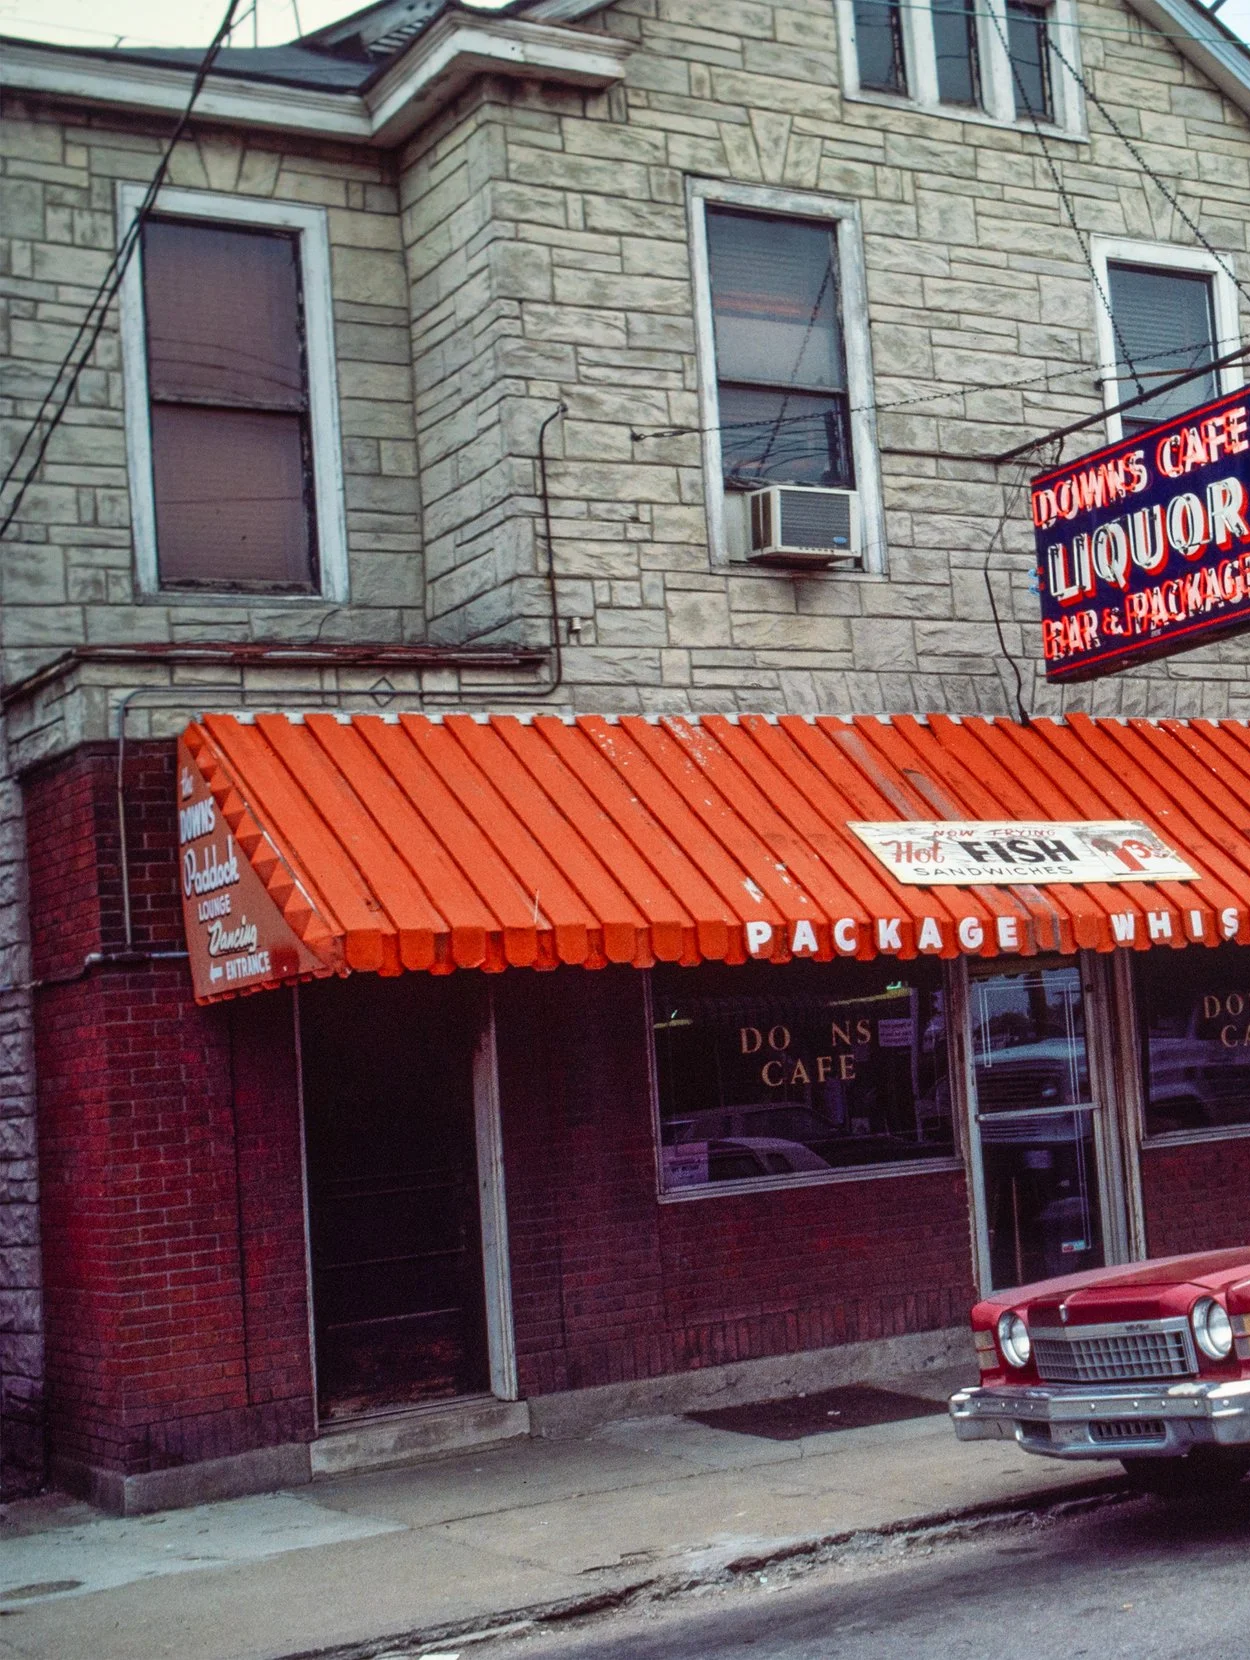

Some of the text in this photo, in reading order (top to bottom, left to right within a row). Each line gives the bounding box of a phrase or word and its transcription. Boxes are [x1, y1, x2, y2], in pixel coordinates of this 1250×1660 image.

[1031, 406, 1250, 530] DOWNS CAFE
[1042, 610, 1102, 662] BAR
[179, 796, 216, 845] DOWNS
[932, 829, 975, 837] NOW
[183, 834, 240, 897] Paddock
[880, 839, 946, 865] Hot
[957, 839, 1081, 865] FISH
[913, 865, 1074, 877] SANDWICHES
[198, 893, 232, 922] LOUNGE
[207, 914, 258, 956] Dancing
[745, 916, 1018, 954] PACKAGE
[225, 950, 272, 981] ENTRANCE
[760, 1054, 856, 1088] CAFE
